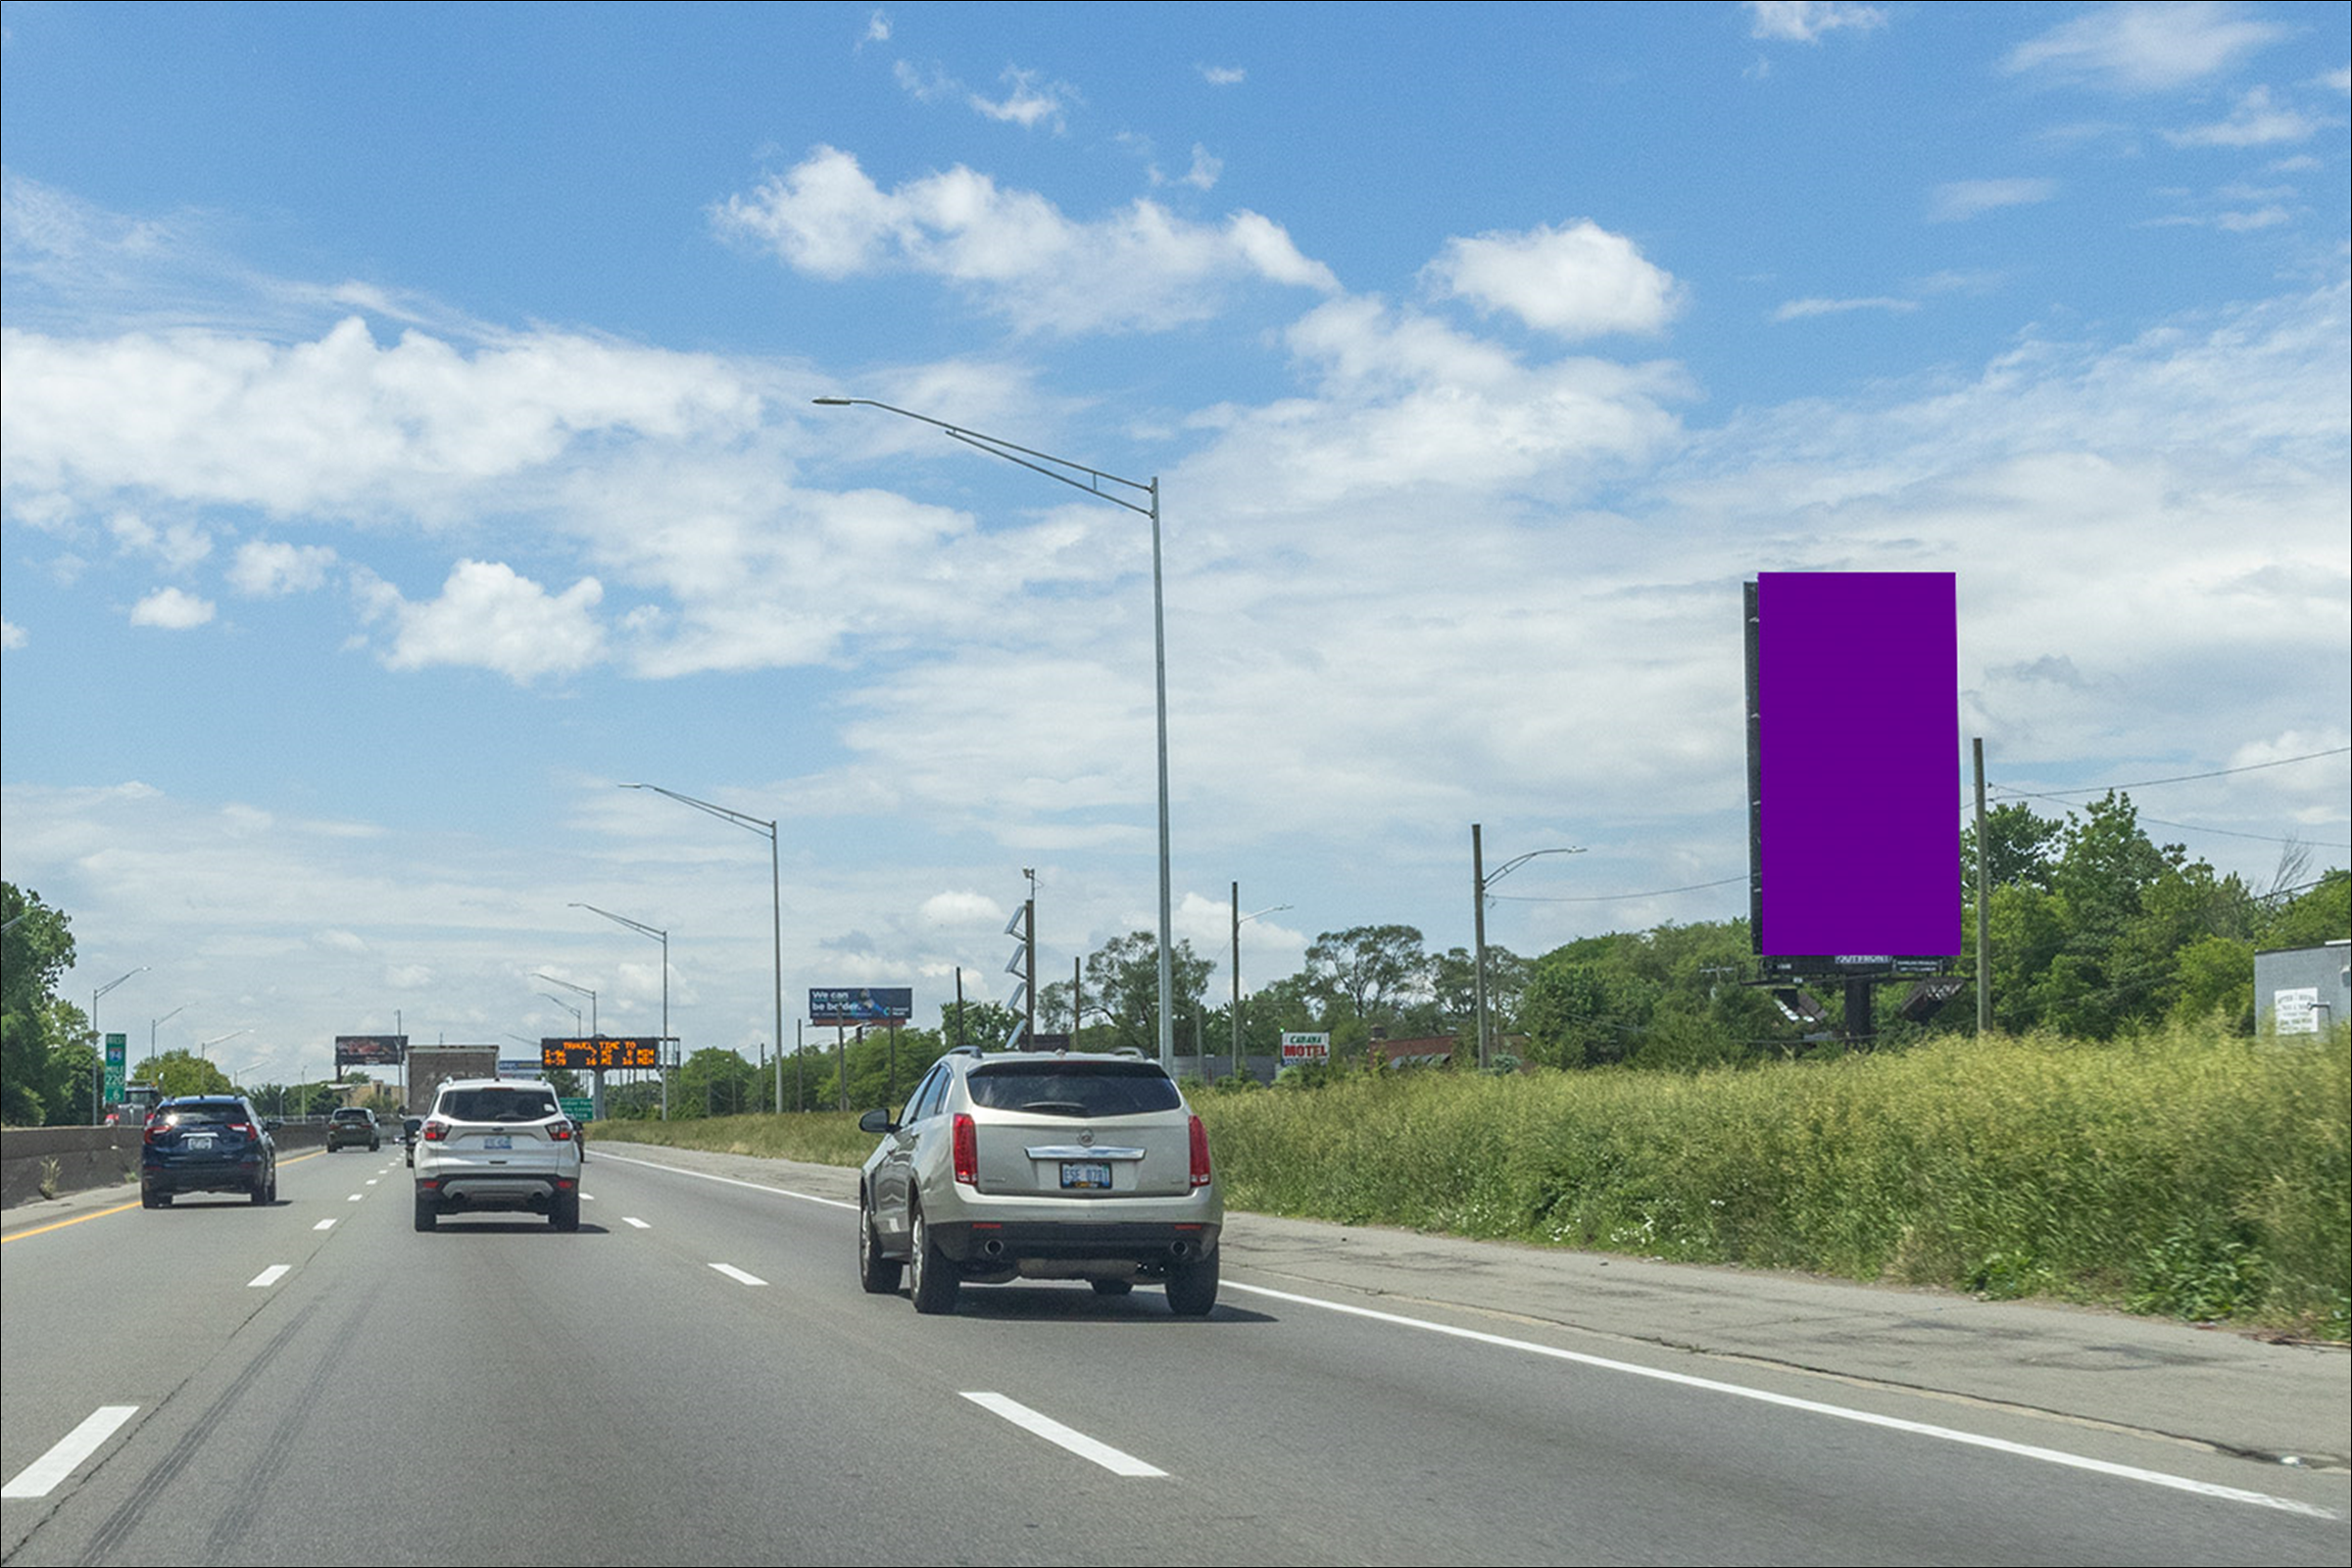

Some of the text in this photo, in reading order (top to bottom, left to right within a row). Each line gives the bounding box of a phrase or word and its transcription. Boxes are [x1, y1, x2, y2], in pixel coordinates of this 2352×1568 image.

[811, 991, 850, 1000] We can
[811, 1002, 826, 1011] be
[1284, 1044, 1328, 1057] MOTEL
[105, 1074, 124, 1086] 220
